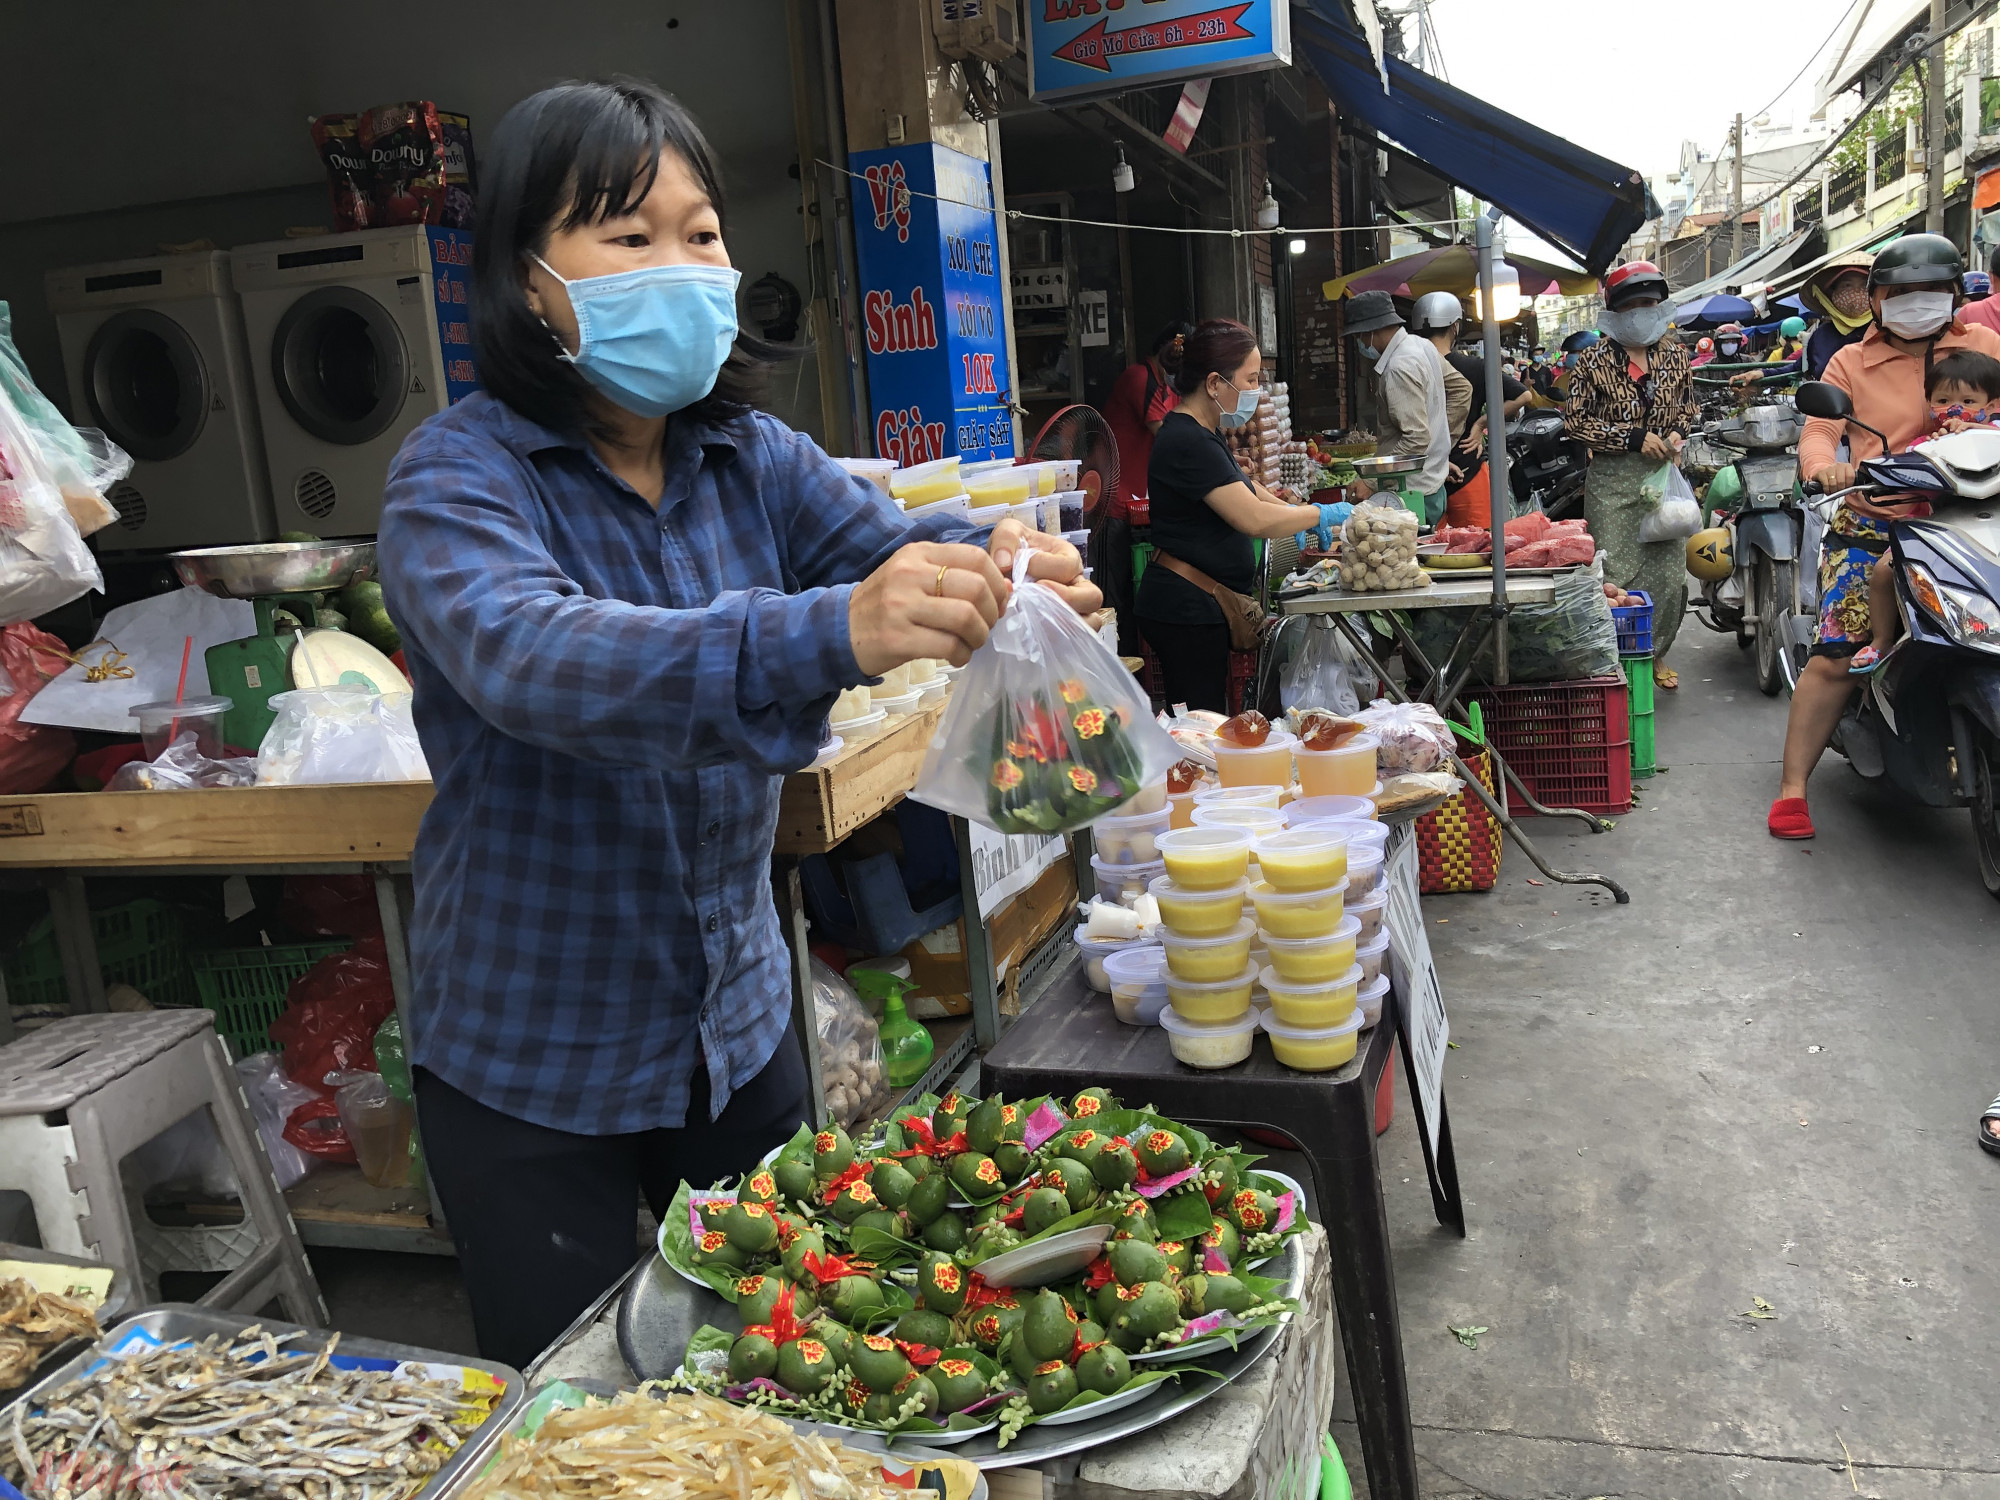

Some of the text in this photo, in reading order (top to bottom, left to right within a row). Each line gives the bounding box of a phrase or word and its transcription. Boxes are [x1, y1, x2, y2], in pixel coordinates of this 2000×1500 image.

[1073, 41, 1098, 59] Giờ
[1102, 33, 1124, 55] Mở
[1129, 29, 1160, 52] Cửa:
[1164, 24, 1184, 44] 6h
[1198, 17, 1228, 39] 23h
[371, 145, 425, 167] Downy
[865, 160, 911, 243] Vệ
[972, 233, 994, 277] CHÈ
[865, 286, 938, 354] Sinh
[956, 292, 978, 338] XÔI
[1080, 302, 1106, 334] XE
[963, 352, 997, 394] 10K
[876, 406, 945, 468] Giày
[957, 411, 1011, 455] GIẶT SẤY
